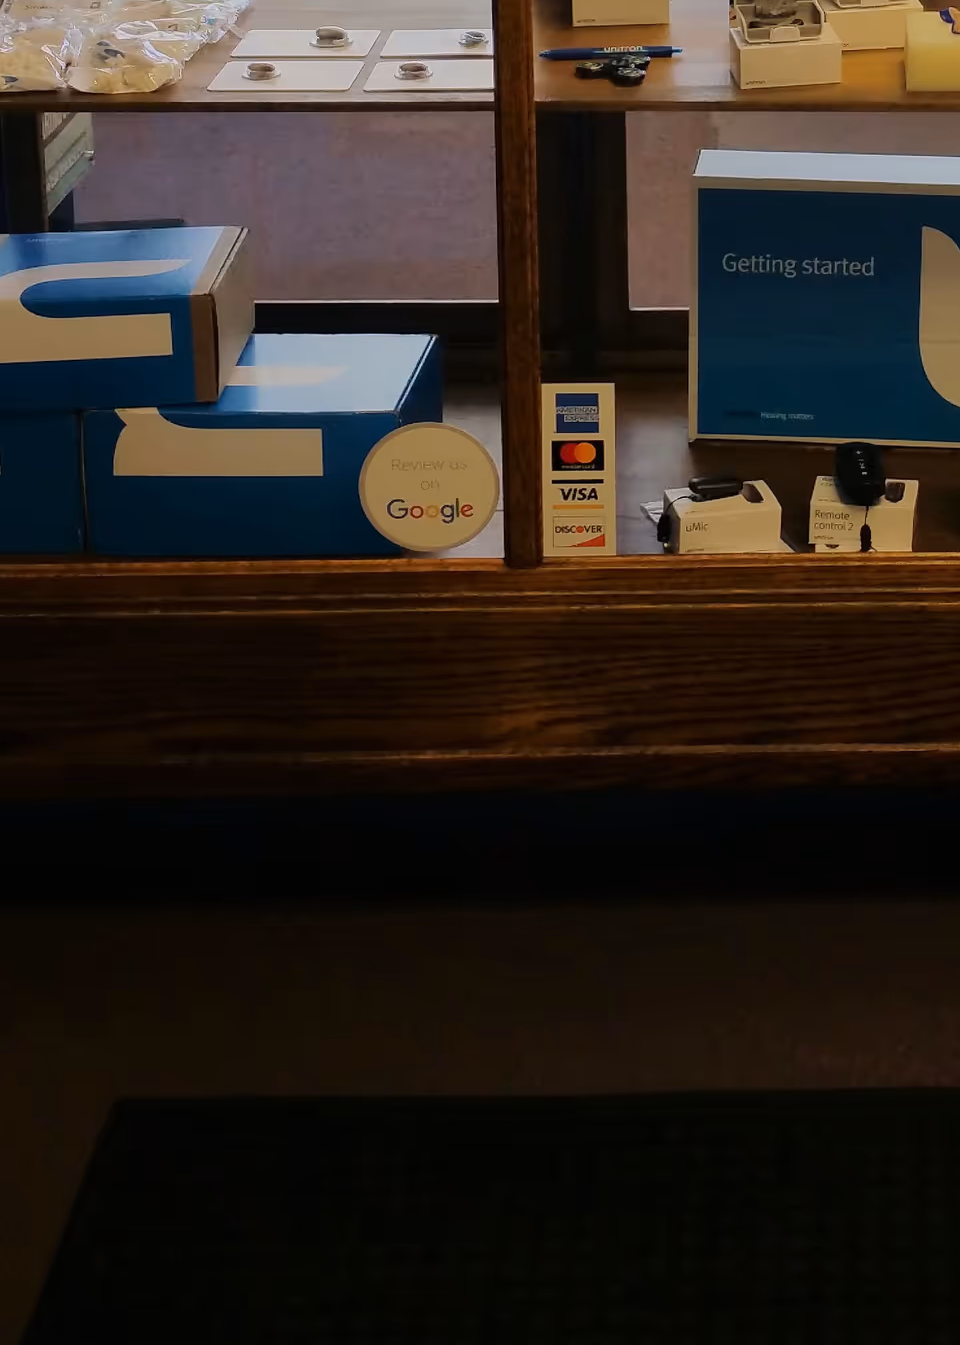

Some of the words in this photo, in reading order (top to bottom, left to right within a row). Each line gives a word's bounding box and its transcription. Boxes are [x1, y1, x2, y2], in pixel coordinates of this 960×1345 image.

[722, 253, 797, 278] Getting
[802, 256, 875, 276] started
[391, 459, 444, 471] Review
[559, 487, 599, 501] VISA
[387, 497, 474, 524] Google
[814, 509, 850, 520] Remote
[555, 525, 603, 534] DISCOVER
[814, 522, 846, 531] control
[848, 523, 854, 531] 2
